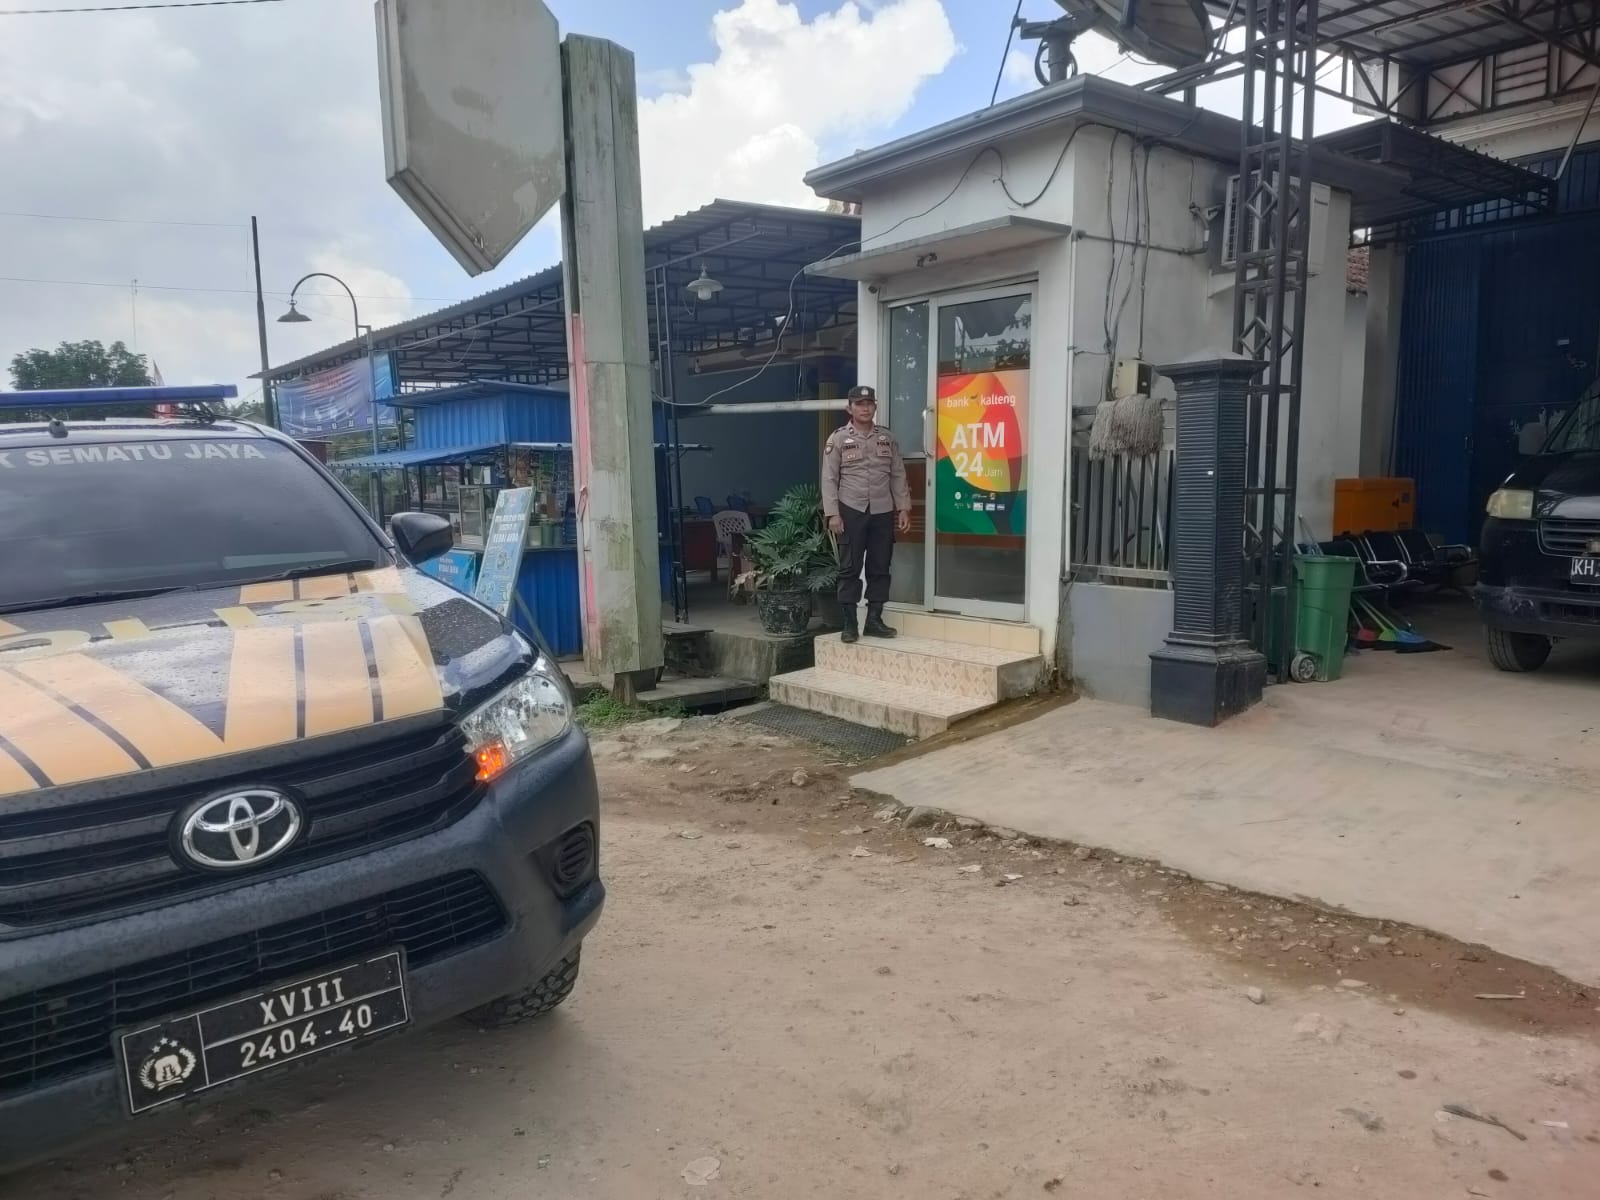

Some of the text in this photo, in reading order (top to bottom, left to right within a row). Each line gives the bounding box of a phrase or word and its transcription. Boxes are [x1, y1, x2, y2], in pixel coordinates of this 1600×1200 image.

[946, 393, 1016, 408] bank kalteng
[951, 421, 1005, 449] ATM
[25, 444, 172, 467] SEMATU
[184, 443, 266, 459] JAYA
[955, 451, 983, 477] 24
[260, 977, 345, 1025] XVIII
[240, 1004, 372, 1068] 2404-40
